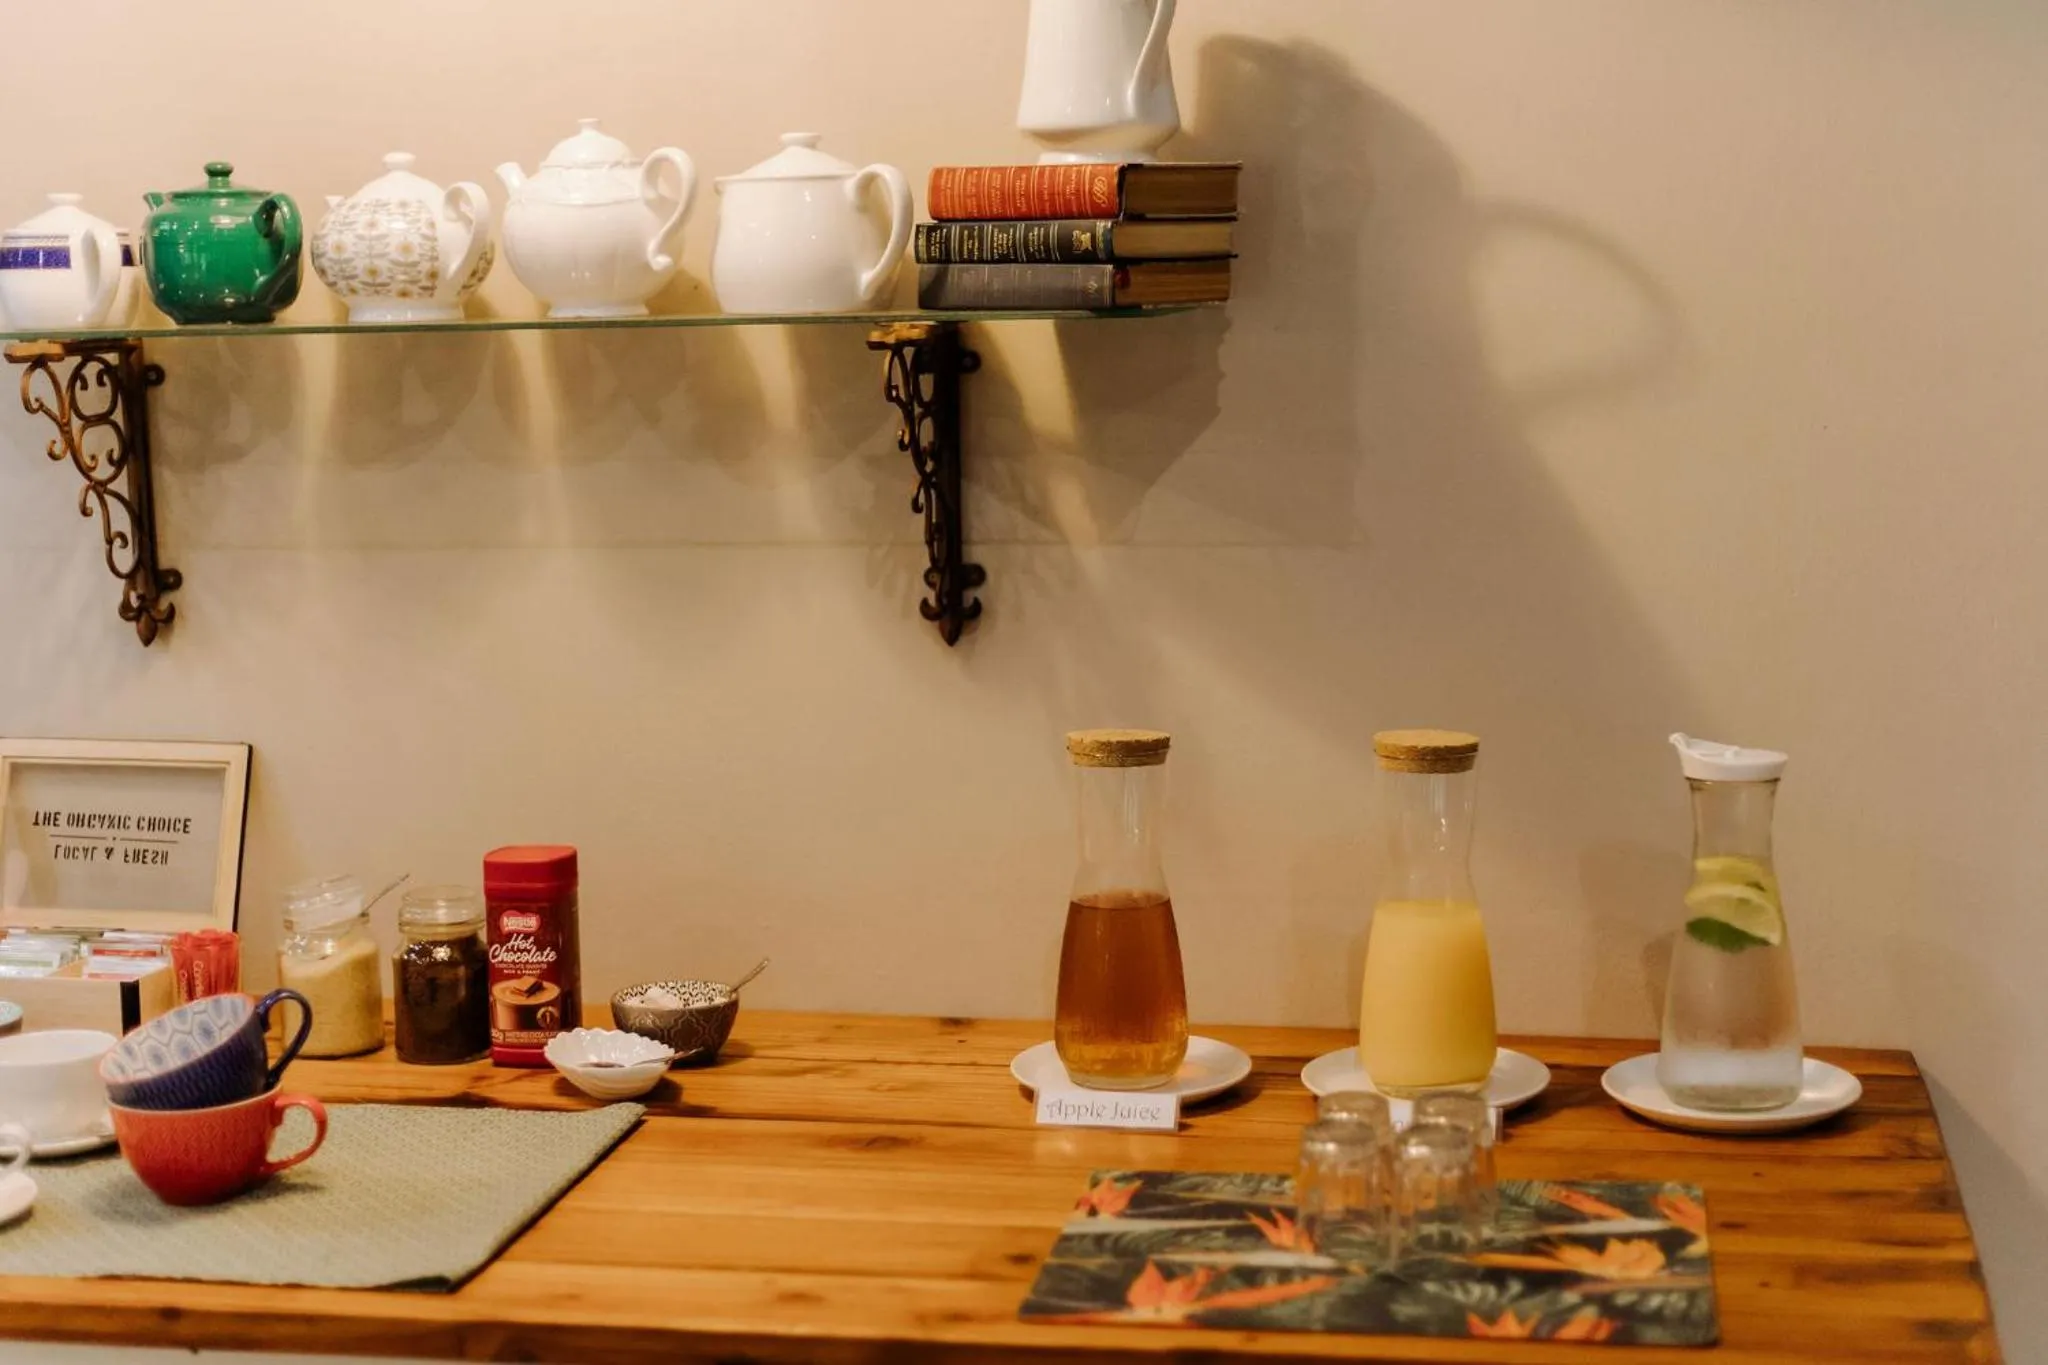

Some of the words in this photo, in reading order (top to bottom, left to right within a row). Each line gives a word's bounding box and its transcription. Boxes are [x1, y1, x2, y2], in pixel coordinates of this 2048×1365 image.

[506, 933, 535, 950] Hot
[490, 944, 557, 963] Chocolate
[1046, 1098, 1105, 1121] Apple
[1110, 1101, 1160, 1121] Juice
